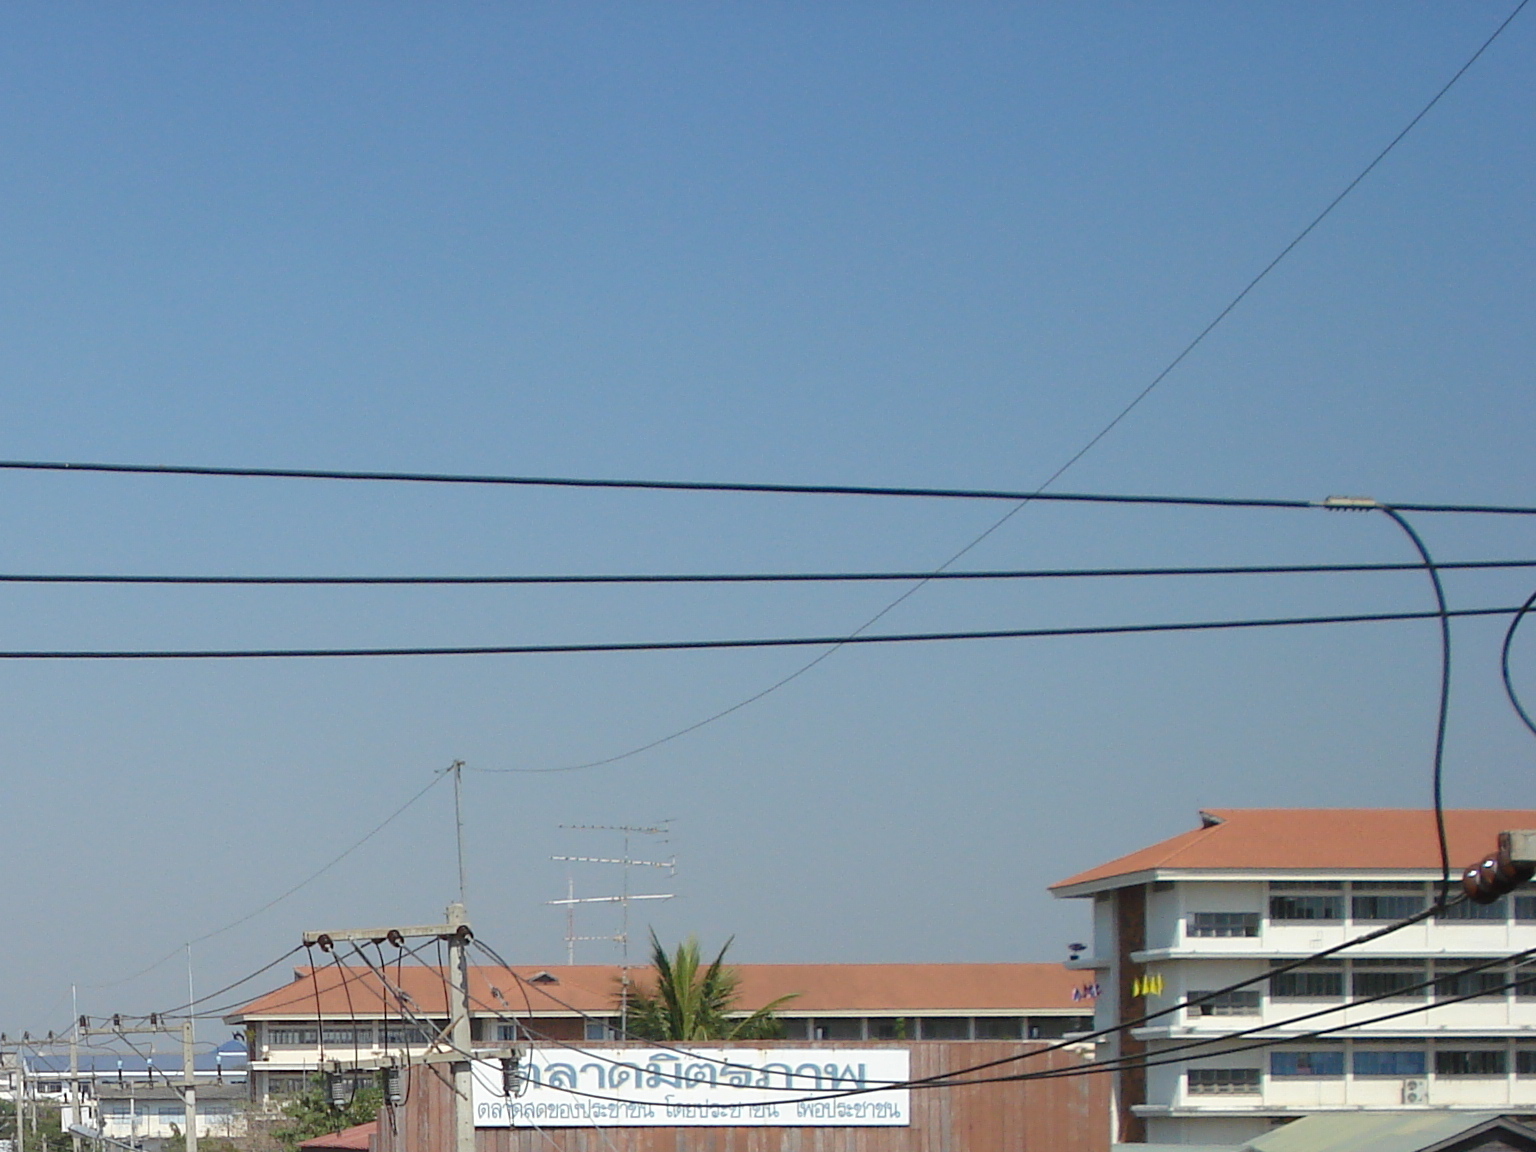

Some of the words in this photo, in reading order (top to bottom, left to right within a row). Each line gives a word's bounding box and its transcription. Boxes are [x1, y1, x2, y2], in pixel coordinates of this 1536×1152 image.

[796, 1093, 902, 1119] เพ่อประชาชน
